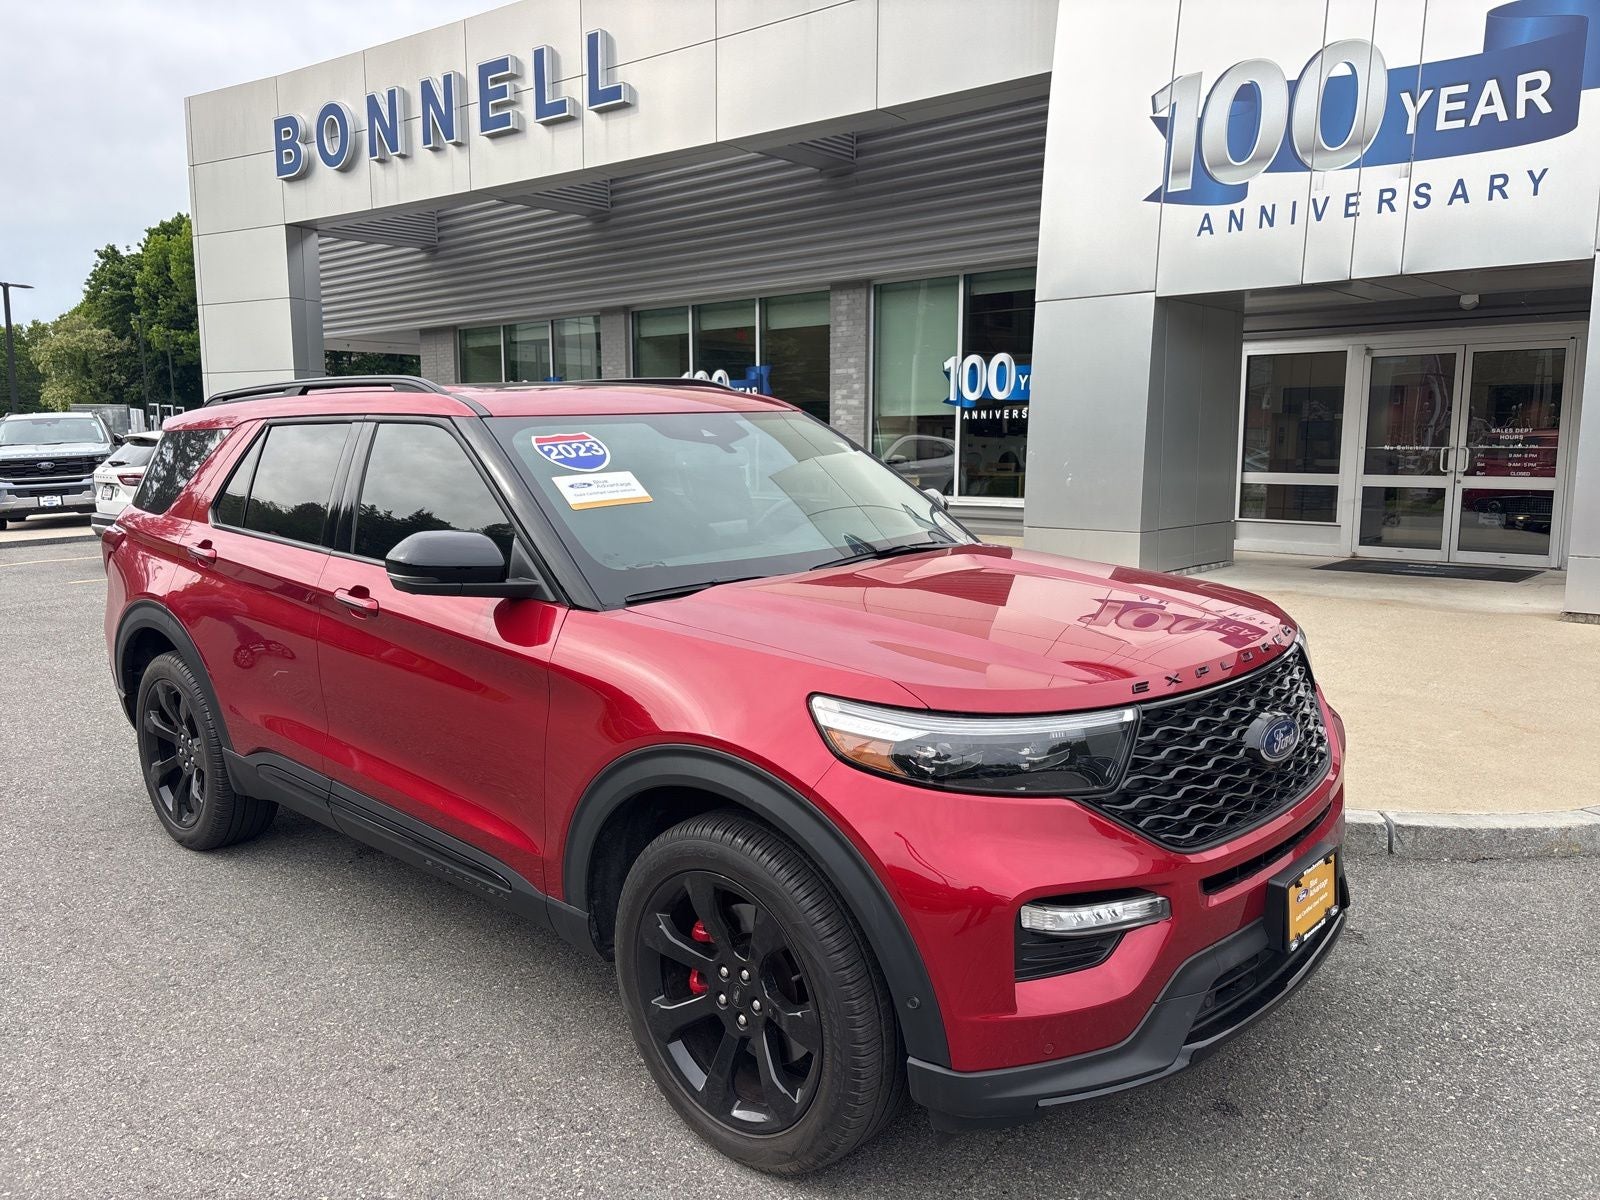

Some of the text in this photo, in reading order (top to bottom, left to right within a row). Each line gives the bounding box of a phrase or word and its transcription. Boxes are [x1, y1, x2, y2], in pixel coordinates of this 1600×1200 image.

[272, 28, 634, 181] BONNELL
[1151, 38, 1553, 193] 100 YEAR
[1196, 168, 1549, 237] ANNIVERSARY
[943, 352, 1032, 401] 100 Y
[542, 442, 605, 460] 2023
[1131, 624, 1295, 694] EXPLORER
[1273, 725, 1294, 753] Ford
